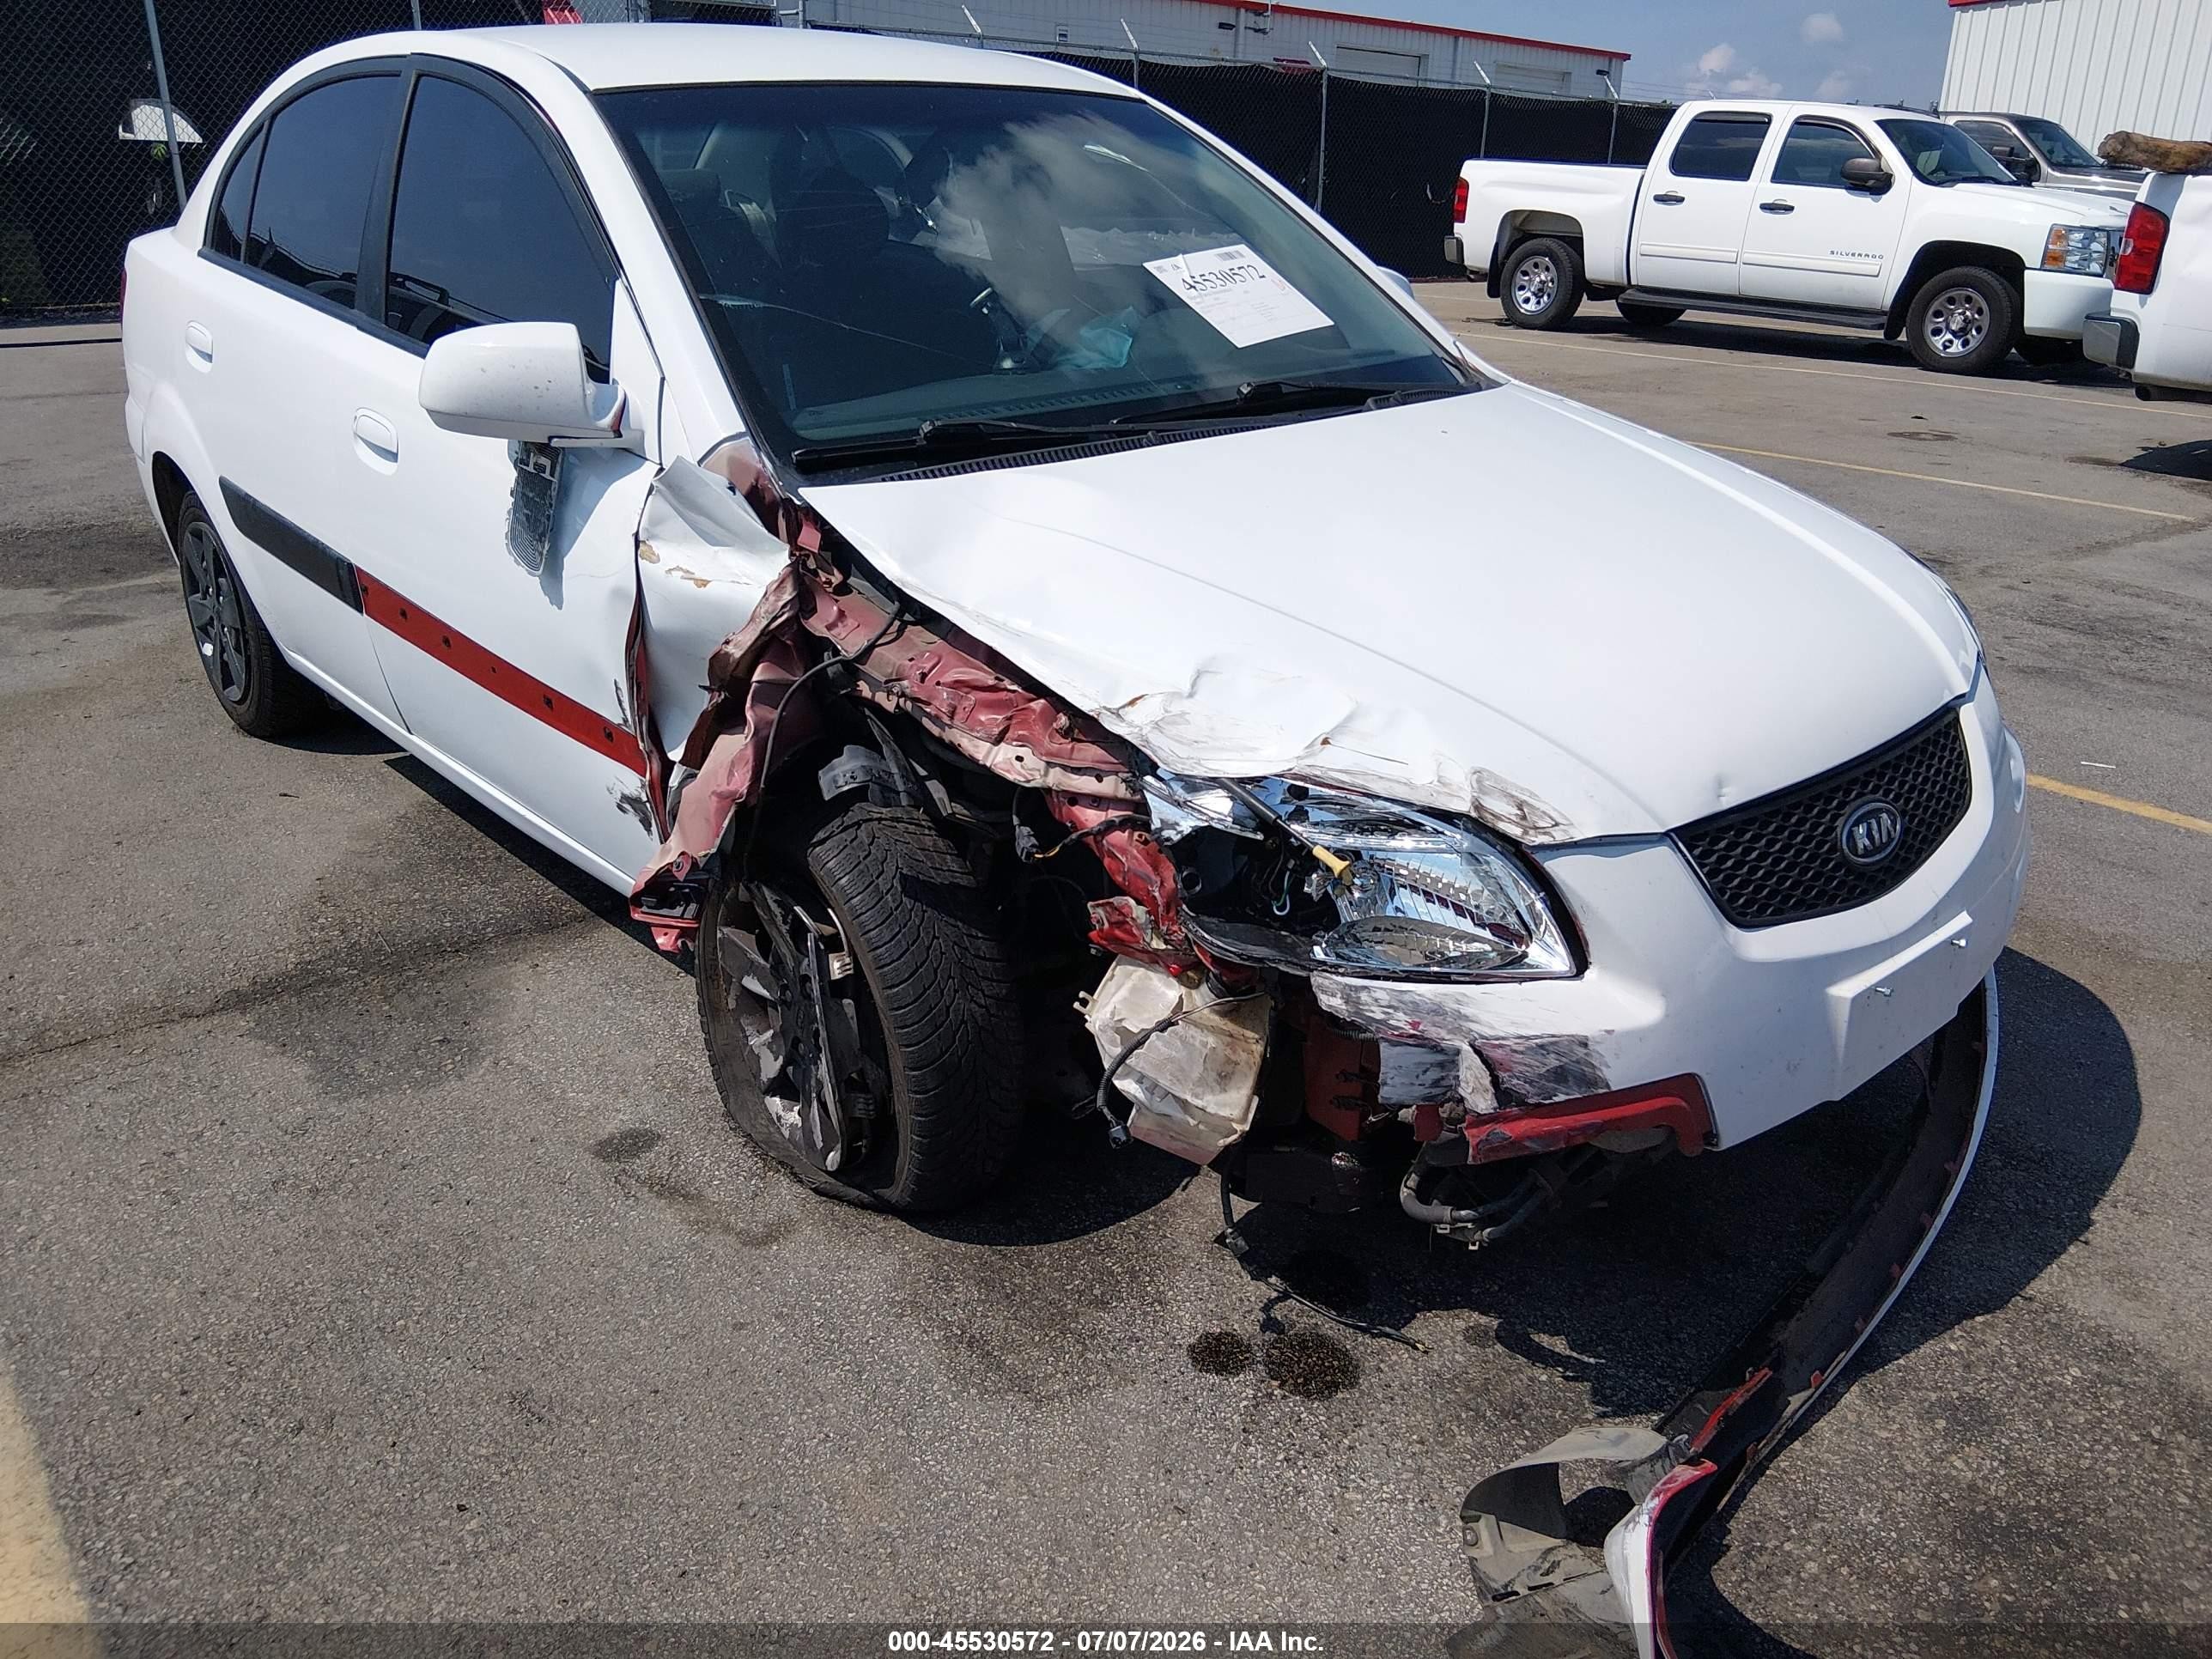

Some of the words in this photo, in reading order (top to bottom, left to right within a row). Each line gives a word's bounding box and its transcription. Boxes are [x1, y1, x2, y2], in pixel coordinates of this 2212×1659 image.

[1830, 250, 1884, 259] SILVERADO
[1182, 264, 1267, 292] 45530572
[1851, 811, 1896, 855] KIA
